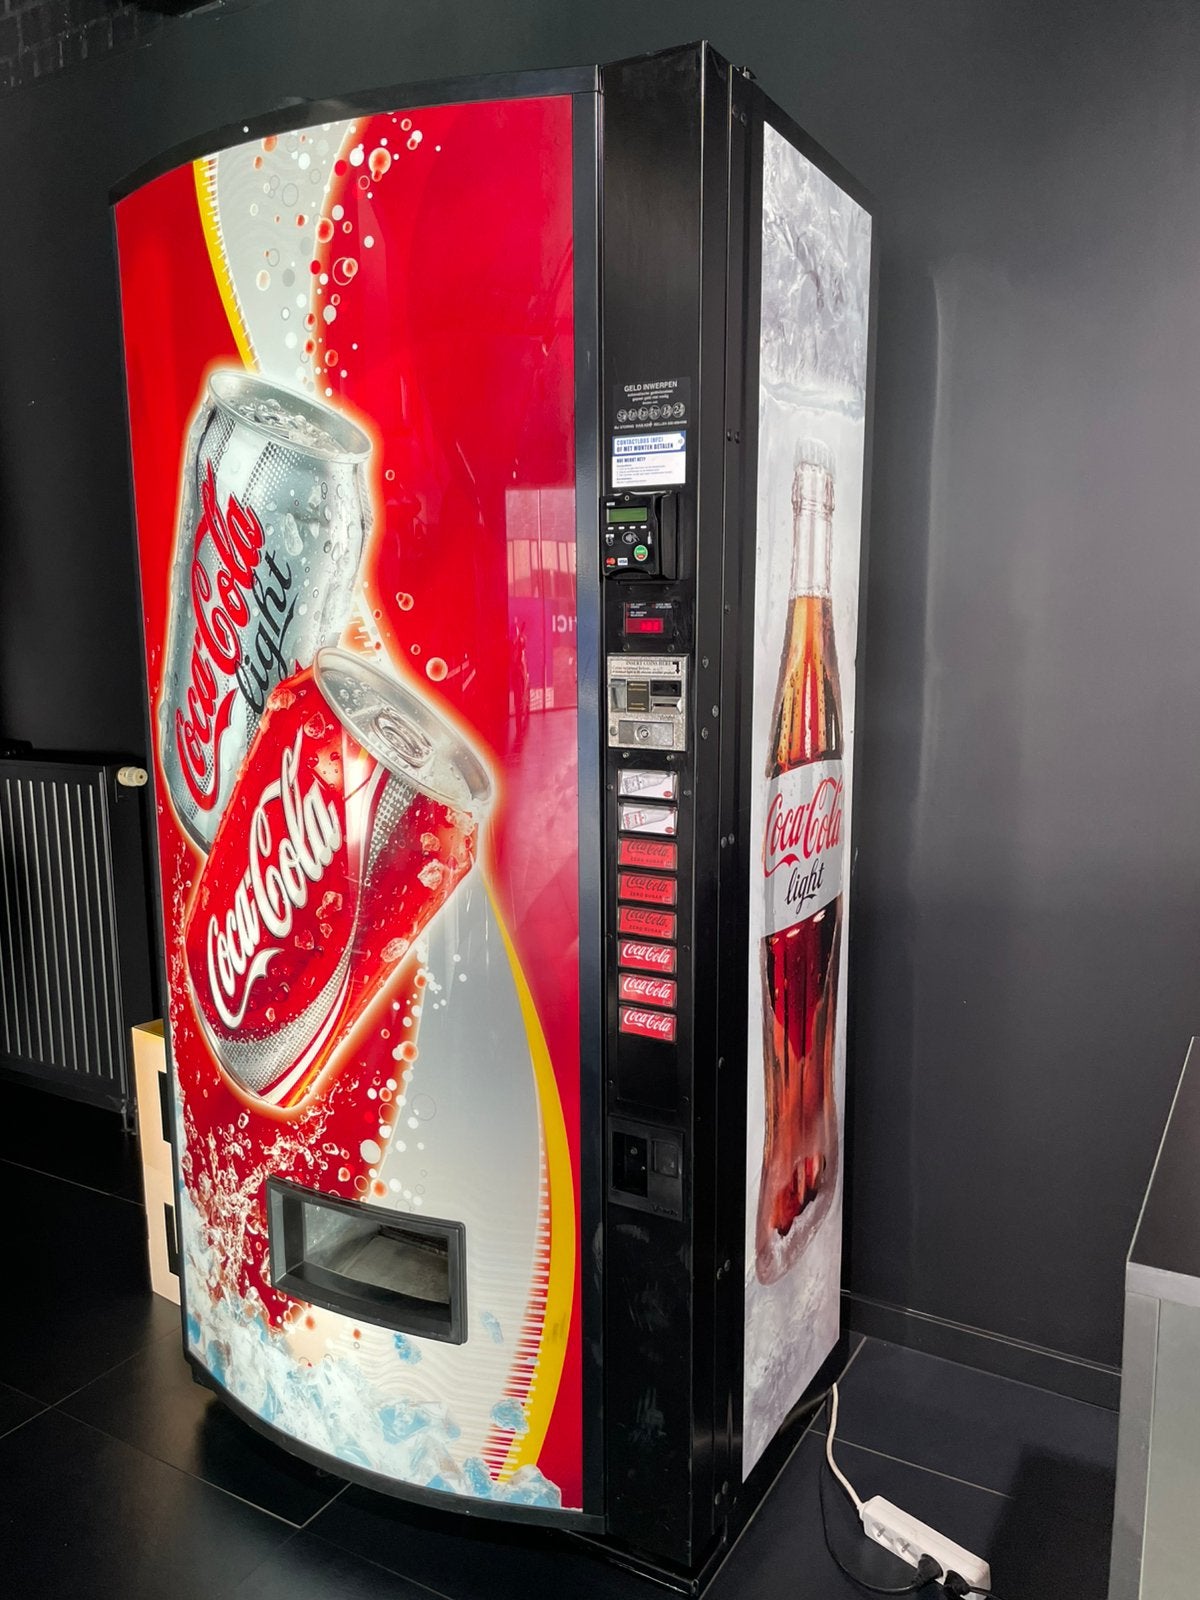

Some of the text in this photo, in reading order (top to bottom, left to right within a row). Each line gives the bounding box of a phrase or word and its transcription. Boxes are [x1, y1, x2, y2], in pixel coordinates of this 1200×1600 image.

[624, 380, 678, 392] GELD INWERPEN
[235, 549, 298, 716] light
[784, 858, 825, 915] light
